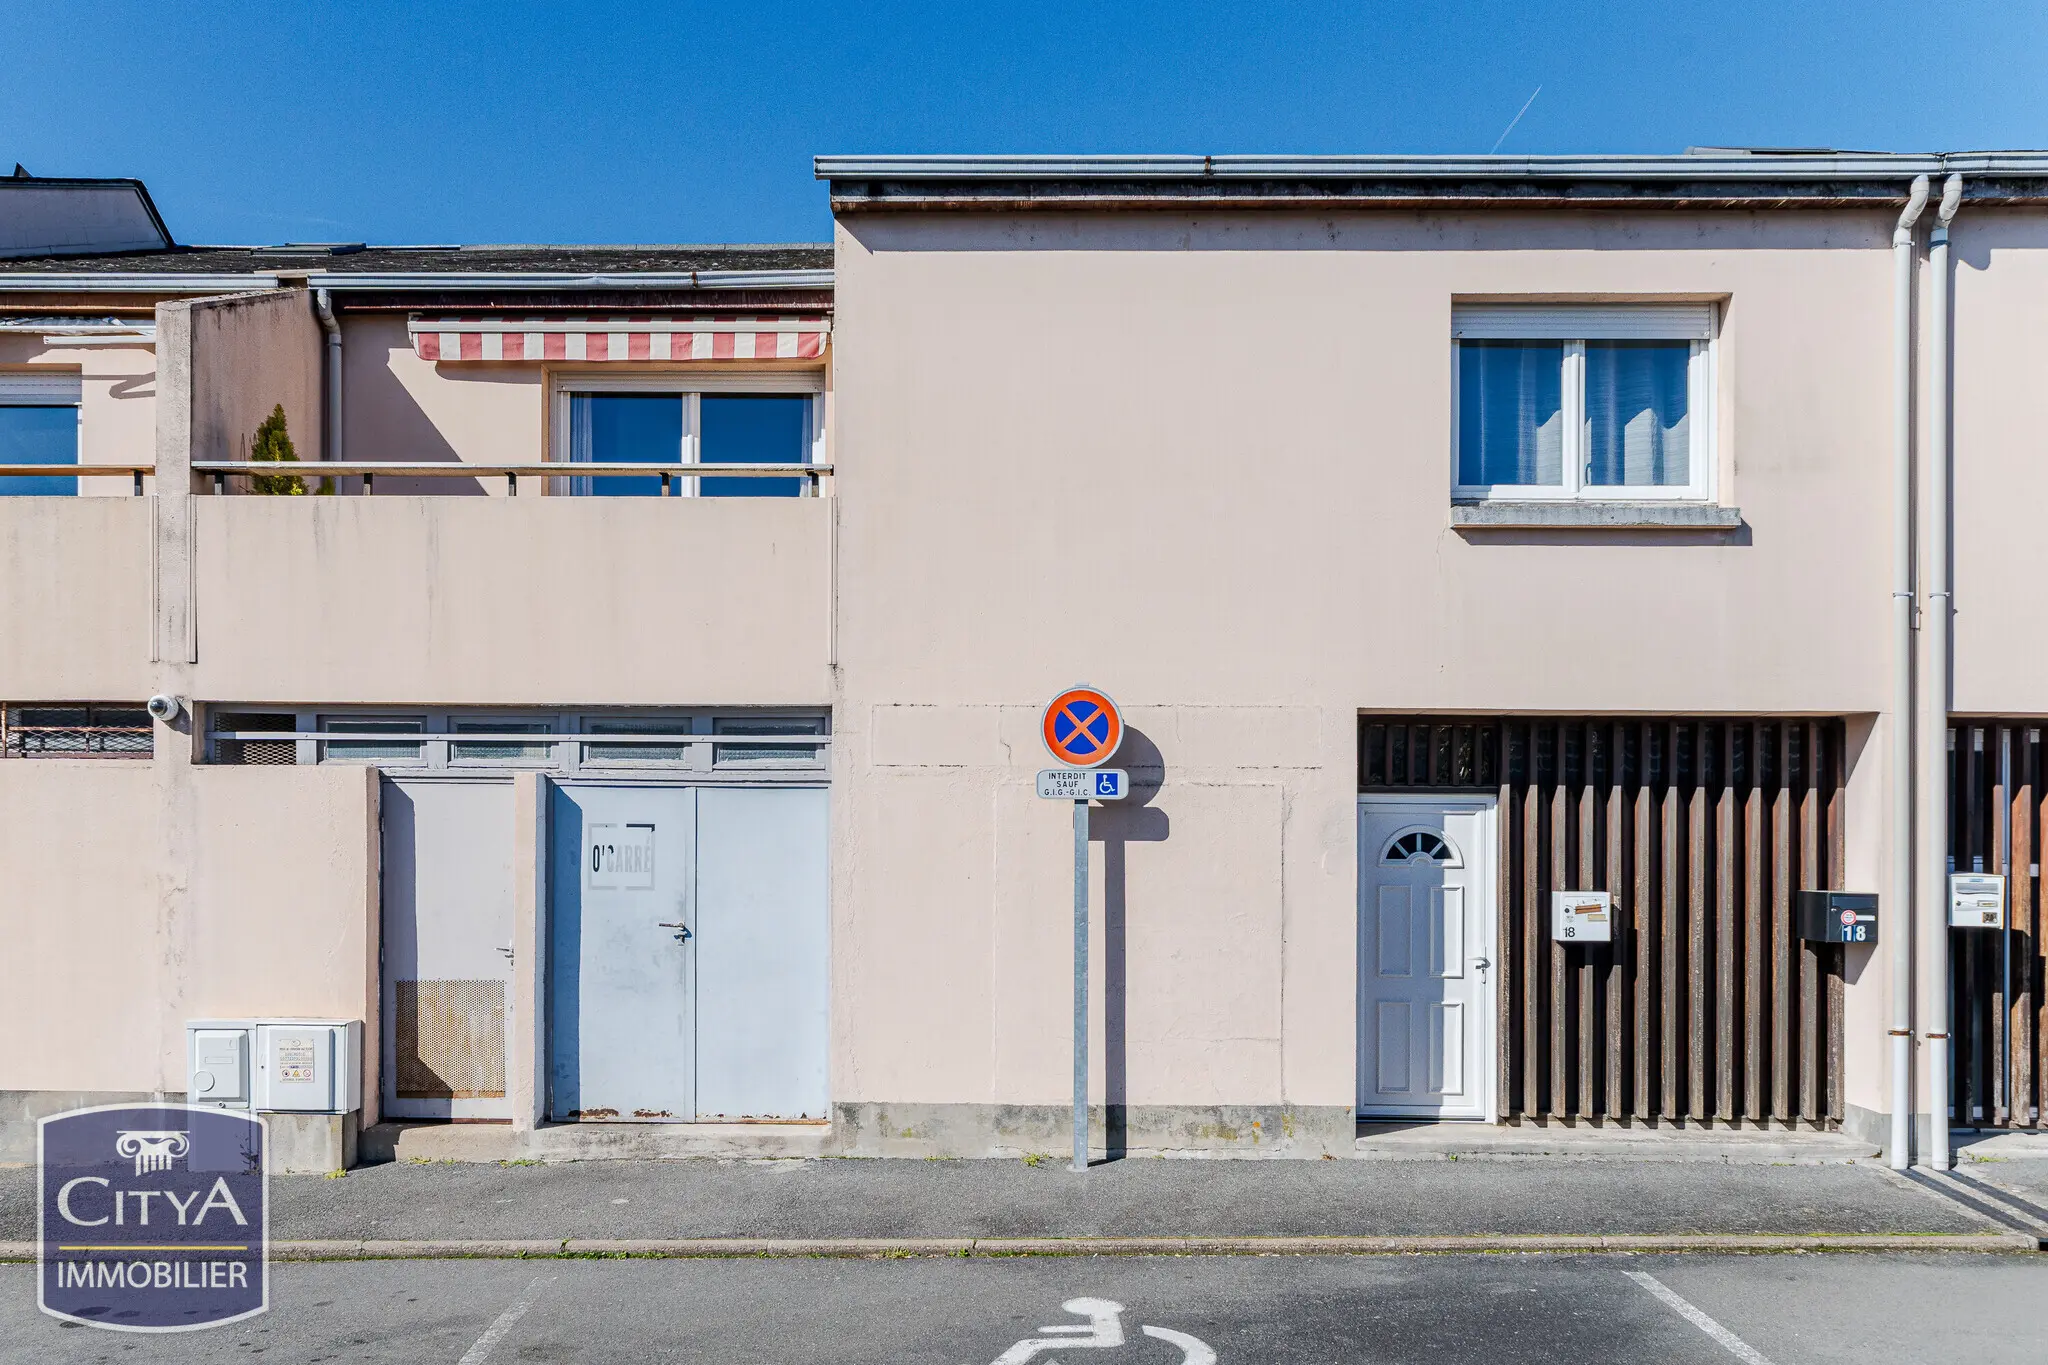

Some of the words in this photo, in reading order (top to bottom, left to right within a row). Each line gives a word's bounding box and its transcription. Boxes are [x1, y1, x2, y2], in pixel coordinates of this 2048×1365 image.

[1048, 772, 1087, 780] INTERDIT
[1563, 926, 1576, 938] 18
[1843, 925, 1866, 942] 18
